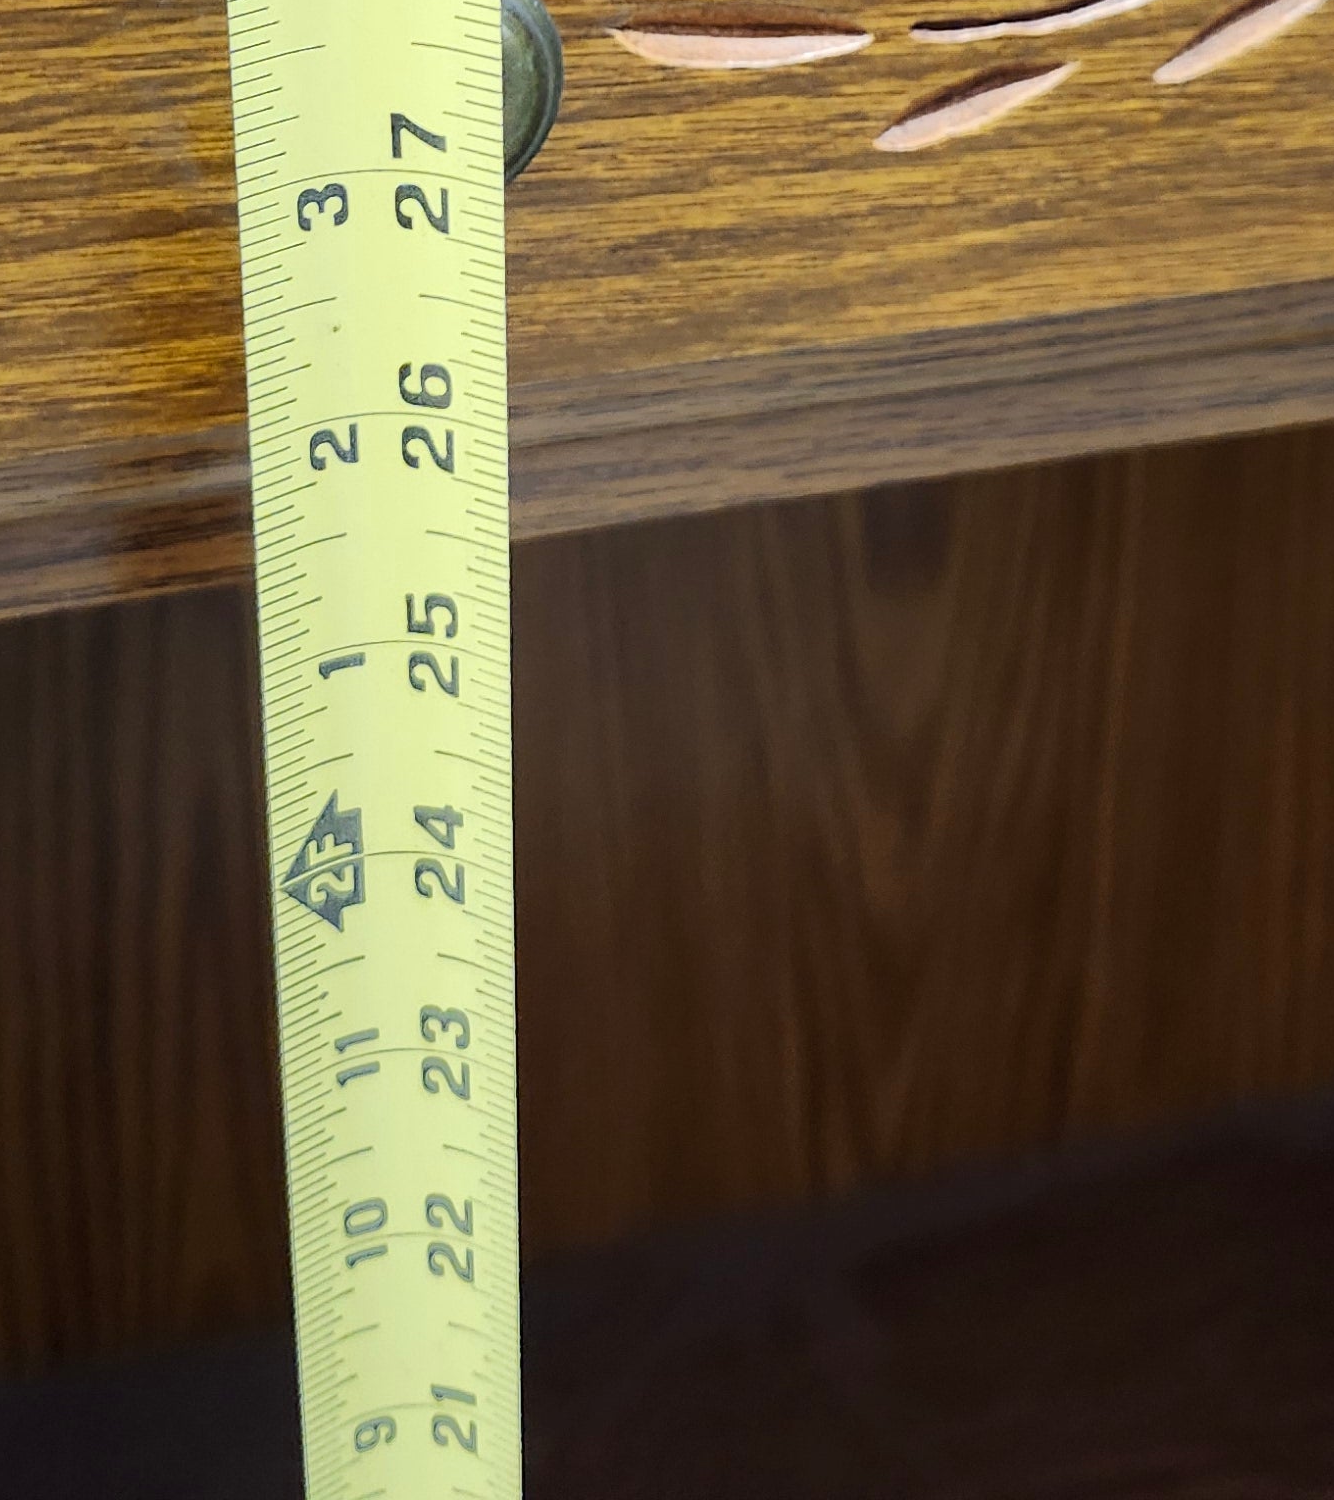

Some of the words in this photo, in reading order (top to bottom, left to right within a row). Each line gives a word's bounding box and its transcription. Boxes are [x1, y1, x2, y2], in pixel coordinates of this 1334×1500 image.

[297, 183, 348, 231] 3
[390, 113, 449, 234] 27
[310, 424, 358, 471] 2
[399, 363, 454, 473] 26
[319, 653, 365, 680] 1
[406, 594, 459, 697] 25
[414, 806, 464, 904] 24
[335, 1029, 379, 1087] 11
[420, 1006, 470, 1100] 23
[344, 1199, 387, 1269] 10
[426, 1194, 473, 1282] 22
[354, 1417, 396, 1453] 9
[432, 1385, 476, 1452] 21
